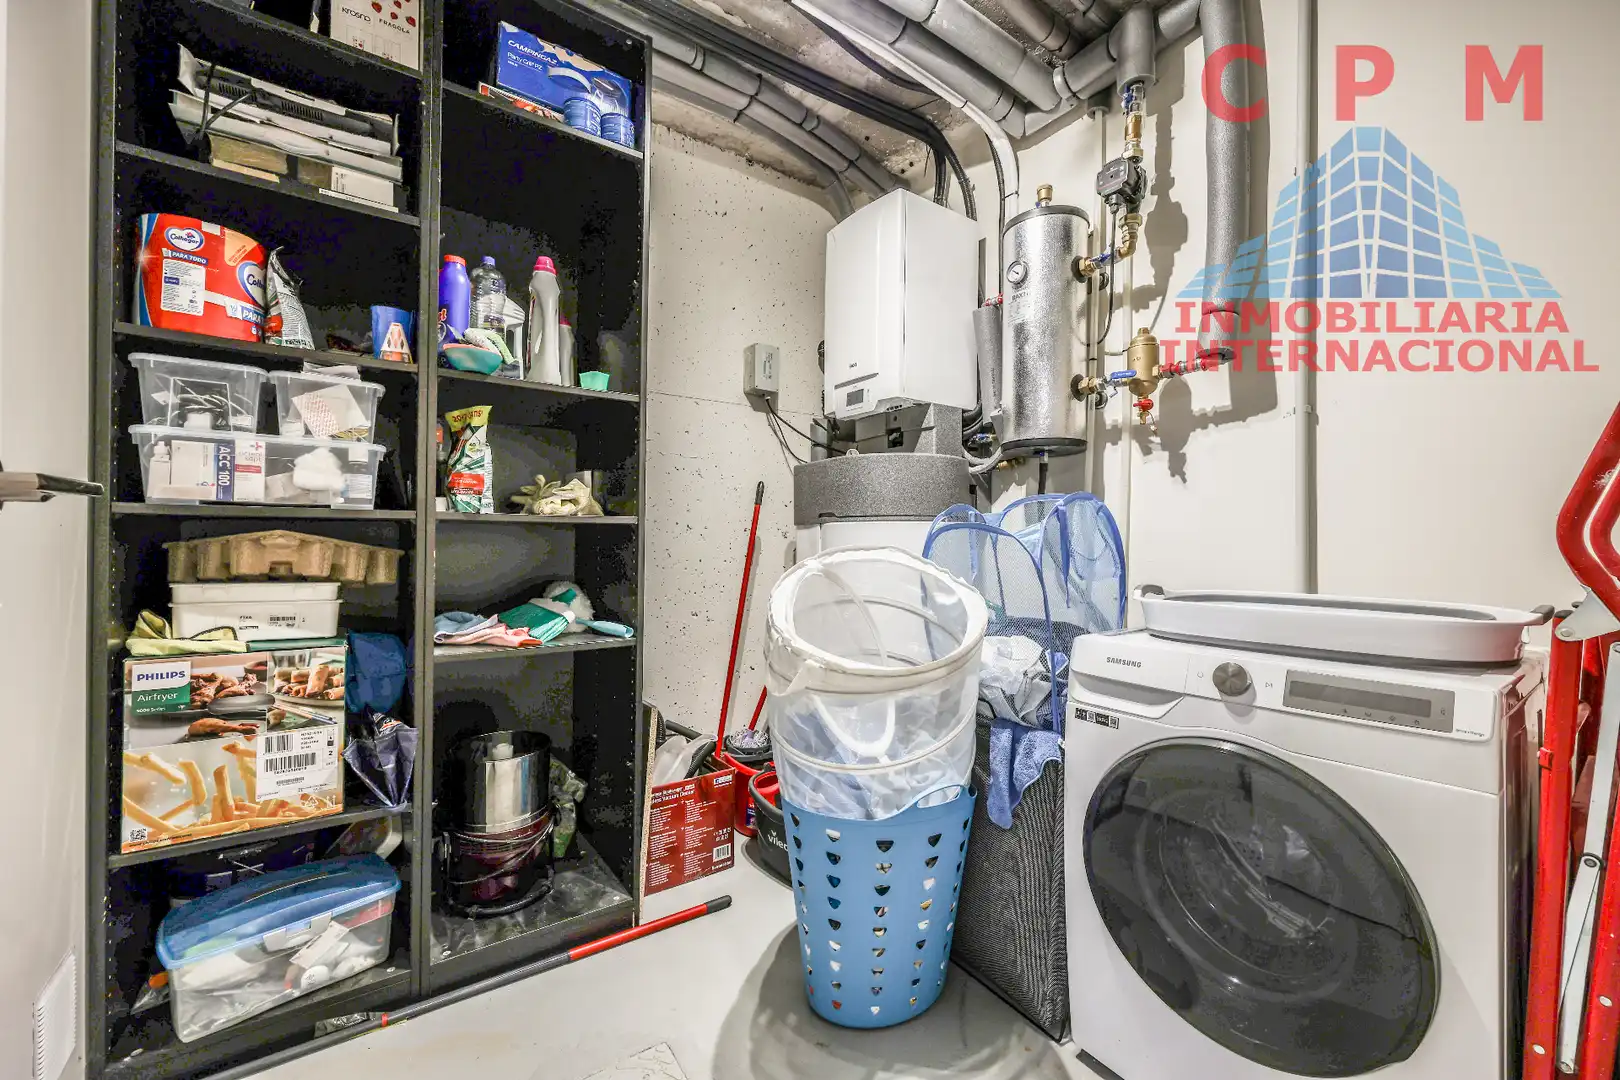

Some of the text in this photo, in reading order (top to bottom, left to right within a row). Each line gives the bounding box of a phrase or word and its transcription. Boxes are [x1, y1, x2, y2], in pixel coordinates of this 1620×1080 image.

[379, 18, 410, 35] FRAGOLA
[508, 40, 558, 66] CAMPINGAZ
[169, 233, 199, 244] Colhogar
[172, 251, 207, 264] PARA TODO
[1106, 656, 1142, 668] SAMSUNG
[136, 670, 186, 681] PHILIPS
[137, 692, 178, 702] Airfryer
